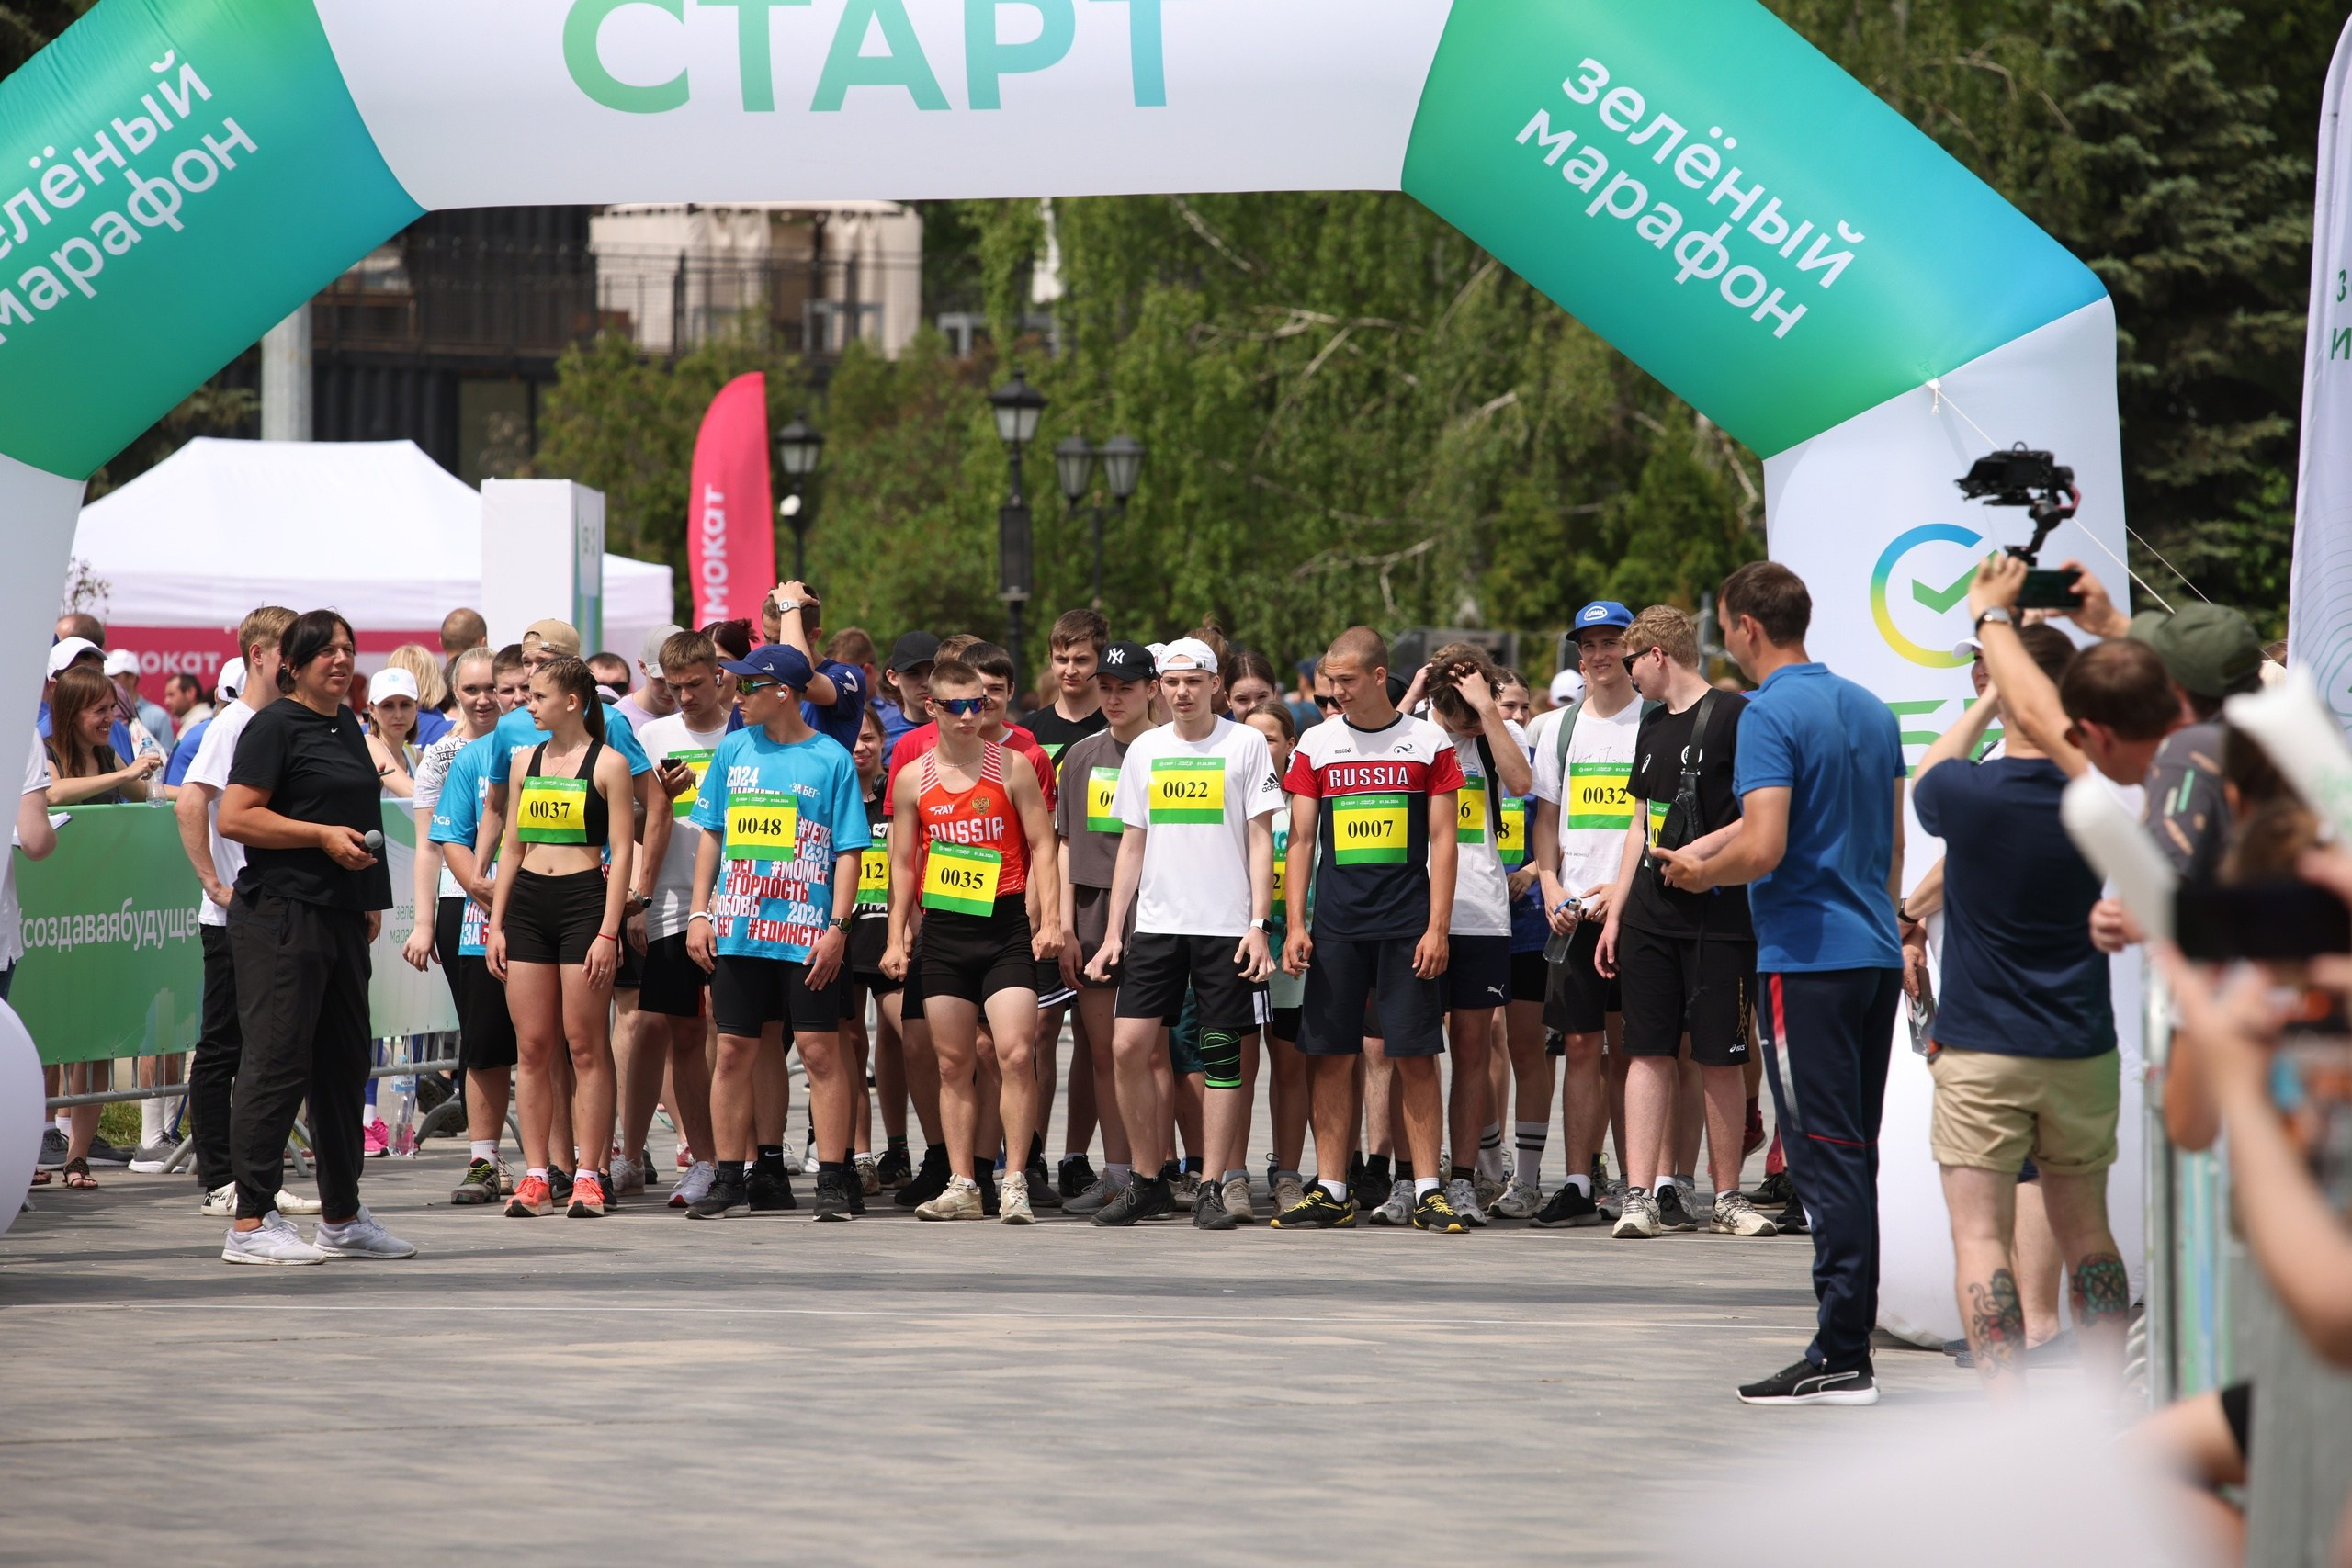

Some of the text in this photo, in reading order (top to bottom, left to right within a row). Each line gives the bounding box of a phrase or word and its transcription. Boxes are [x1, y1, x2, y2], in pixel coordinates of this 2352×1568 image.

[562, 0, 1167, 114] СТАРТ
[0, 49, 213, 260] лёный
[1562, 57, 1866, 289] зелёный
[1515, 108, 1809, 340] марафон
[727, 766, 760, 788] 2024
[1329, 766, 1409, 788] RUSSIA
[1163, 781, 1208, 798] 0022
[1583, 786, 1627, 805] 0032
[529, 800, 571, 818] 0037
[738, 817, 782, 836] 0048
[928, 816, 1005, 844] RUSSIA
[1347, 819, 1394, 839] 0007
[864, 863, 884, 879] 12
[940, 867, 985, 890] 0035
[725, 872, 810, 903] #ГОРДОСТЬ
[714, 894, 762, 919] ЮБОВЬ
[786, 901, 824, 928] 2024
[18, 897, 200, 953] создаваябудуще
